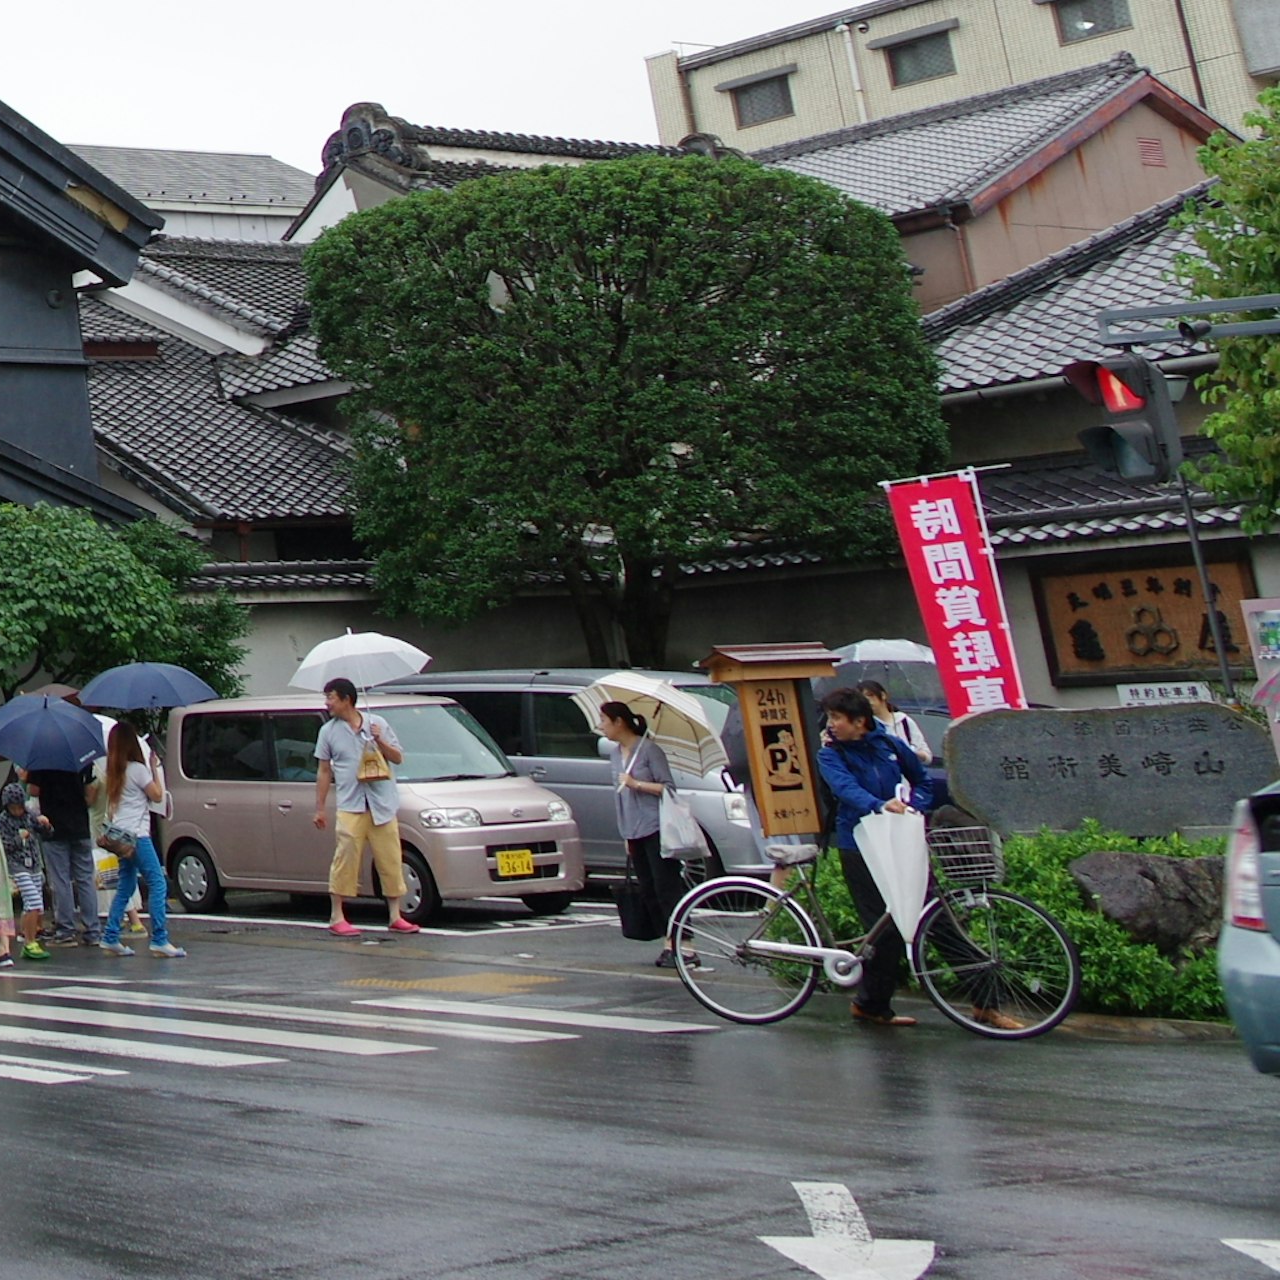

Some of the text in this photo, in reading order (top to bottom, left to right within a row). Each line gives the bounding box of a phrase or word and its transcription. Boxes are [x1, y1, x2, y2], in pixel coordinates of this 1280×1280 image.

[755, 687, 786, 707] 24h
[760, 707, 789, 722] 時間貸
[769, 748, 788, 771] P
[1000, 751, 1226, 781] 山崎美術館
